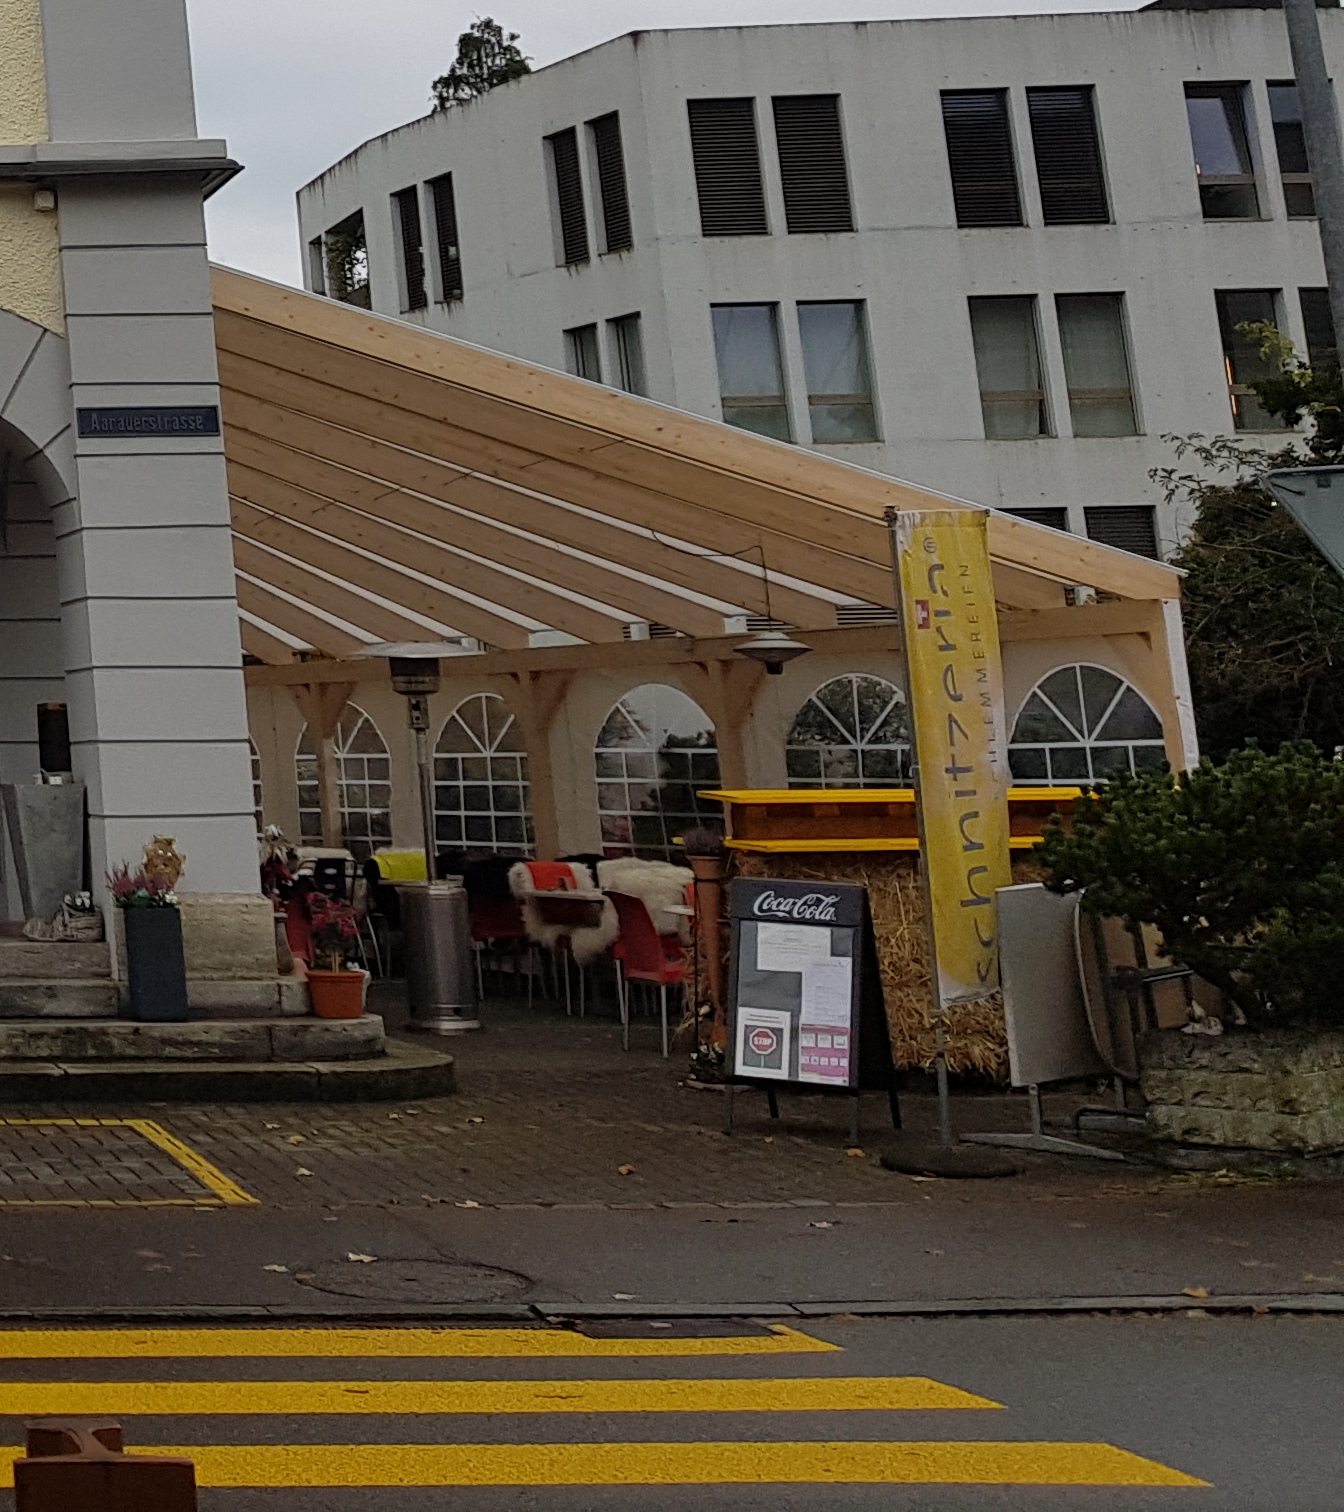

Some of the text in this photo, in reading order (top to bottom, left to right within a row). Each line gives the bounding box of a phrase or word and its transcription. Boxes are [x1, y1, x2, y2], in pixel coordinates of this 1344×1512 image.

[91, 412, 204, 431] Aarauerstrasse
[959, 564, 999, 800] HLEMMEREIEN
[753, 890, 841, 921] Coca-Cola
